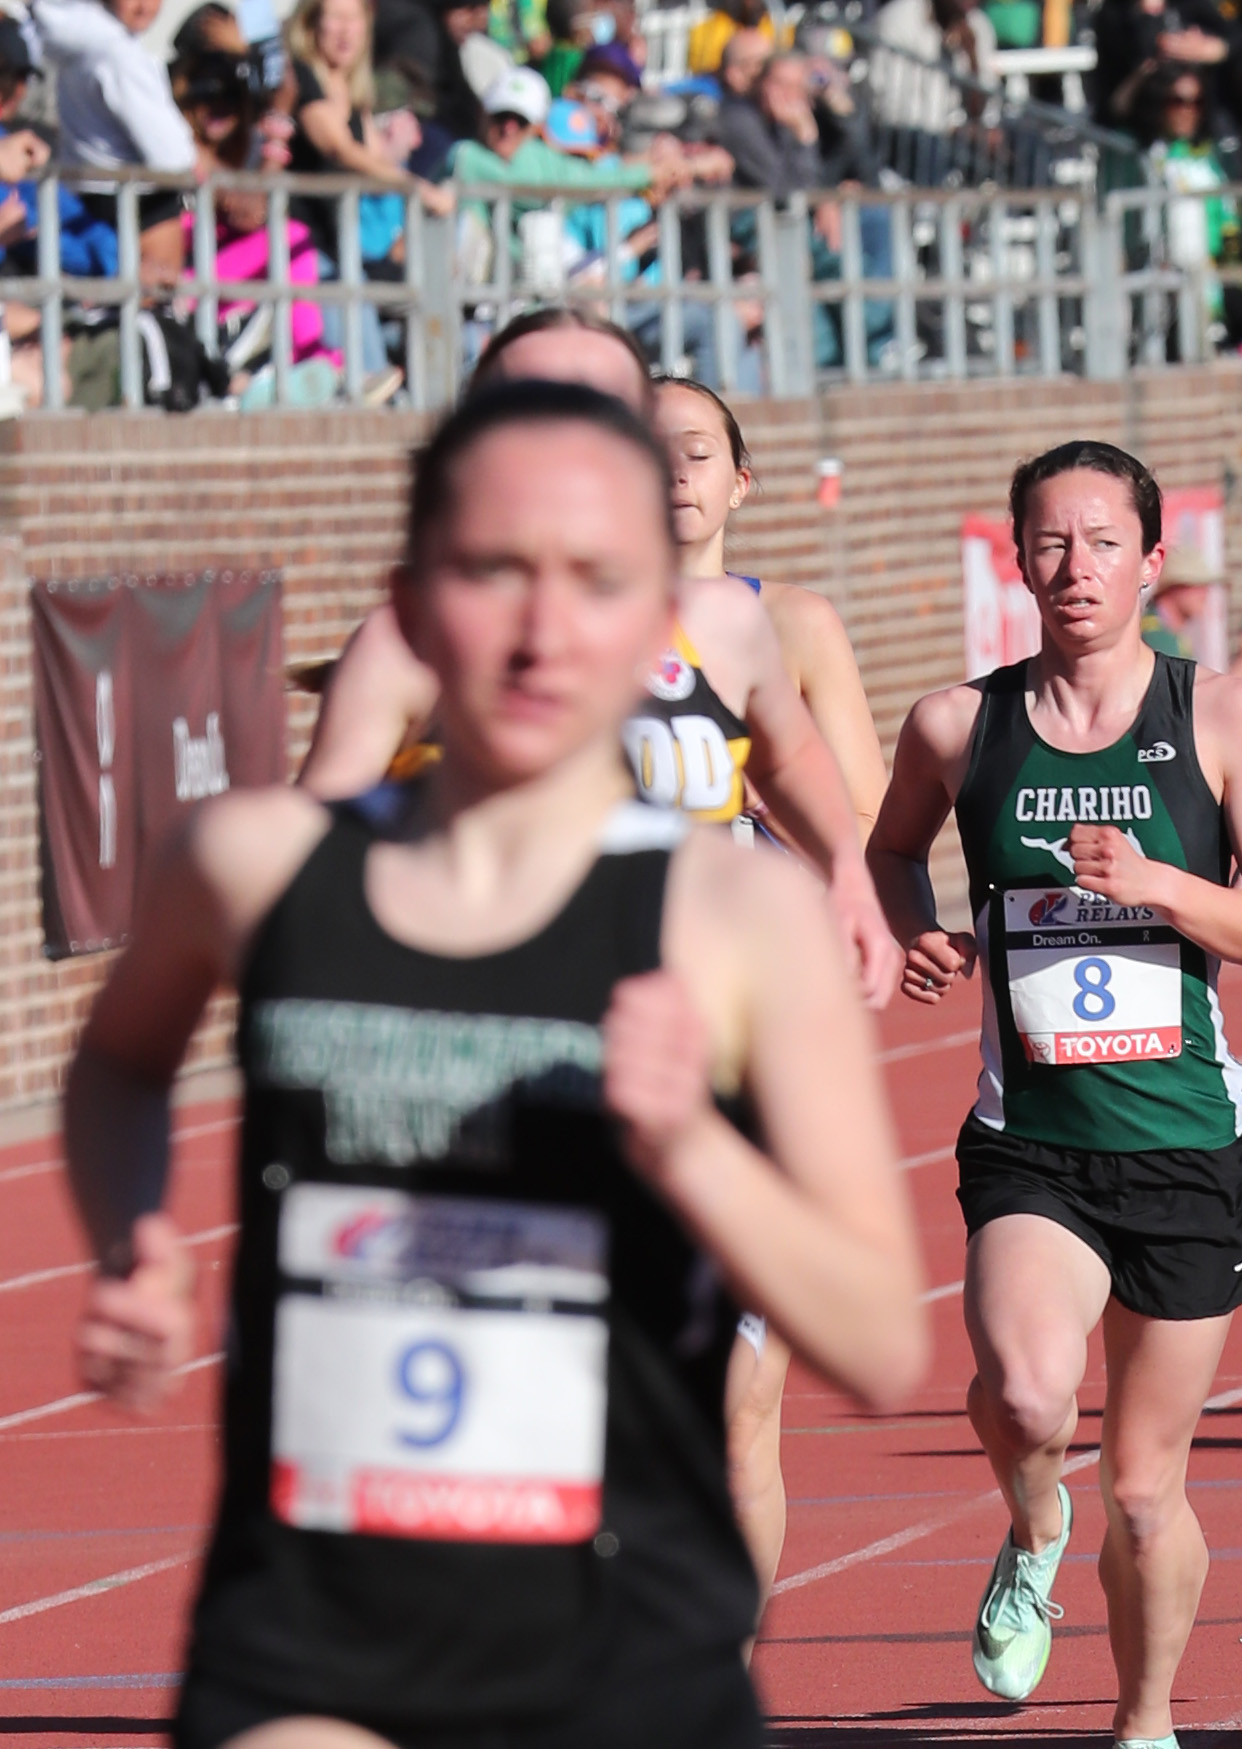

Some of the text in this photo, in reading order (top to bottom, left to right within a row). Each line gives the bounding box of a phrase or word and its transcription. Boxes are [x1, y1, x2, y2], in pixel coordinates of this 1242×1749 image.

[1015, 785, 1153, 822] CHARIHO
[1076, 906, 1155, 922] RELAYS
[1033, 932, 1102, 946] Dream On.
[1073, 957, 1116, 1022] 8
[1060, 1033, 1164, 1057] TOYOTA
[394, 1335, 470, 1453] 9
